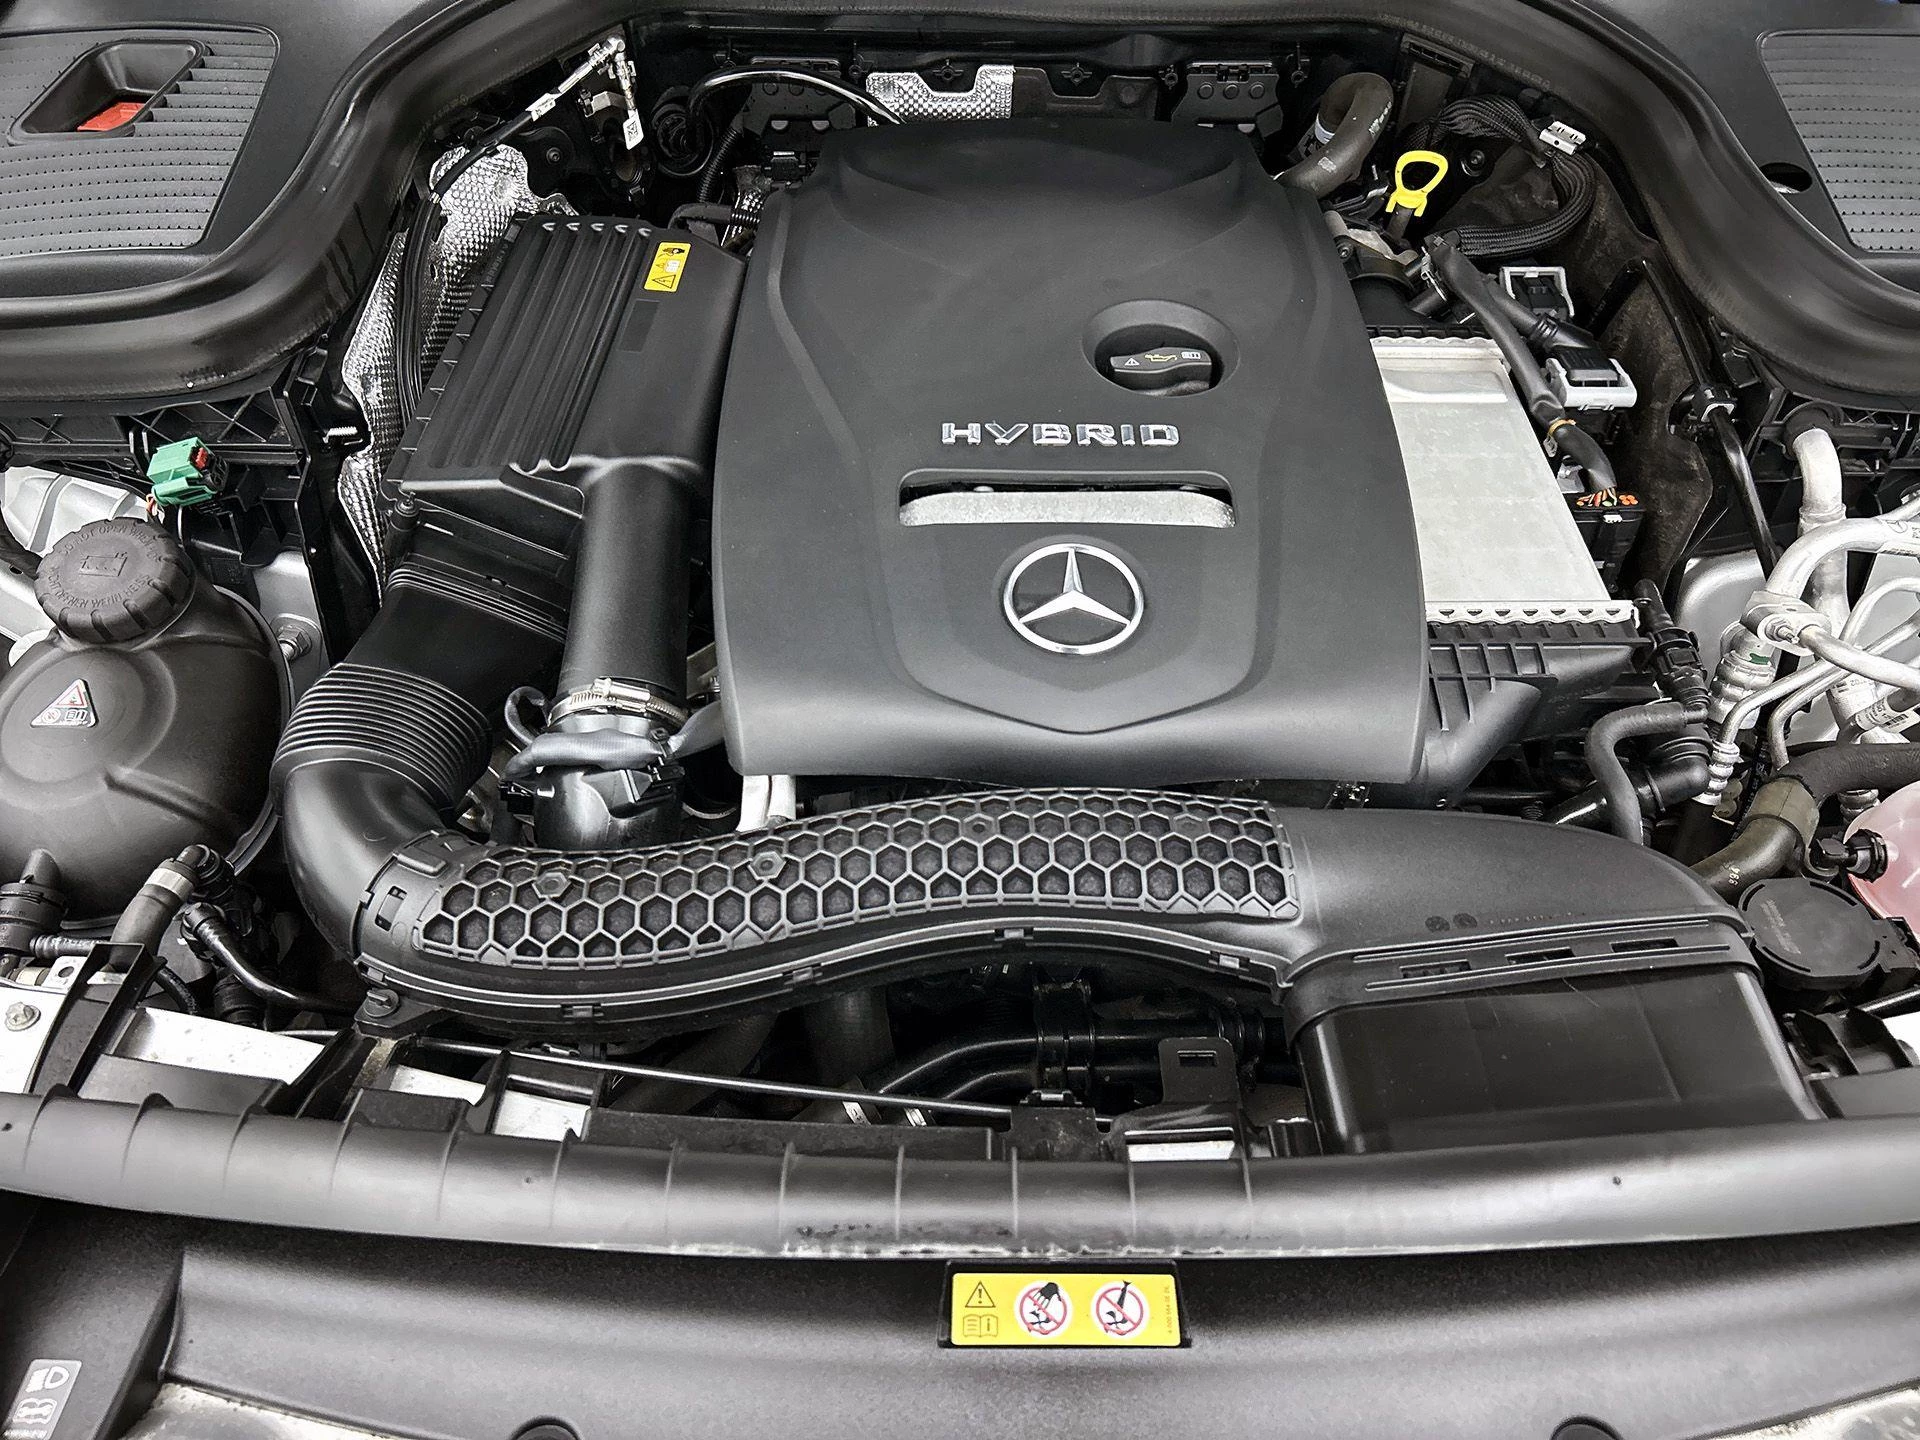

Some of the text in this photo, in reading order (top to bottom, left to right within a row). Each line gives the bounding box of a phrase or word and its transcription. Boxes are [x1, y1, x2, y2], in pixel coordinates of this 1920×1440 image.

[941, 422, 1180, 446] HYBRID
[99, 524, 126, 534] OPEN
[91, 593, 123, 608] WENN
